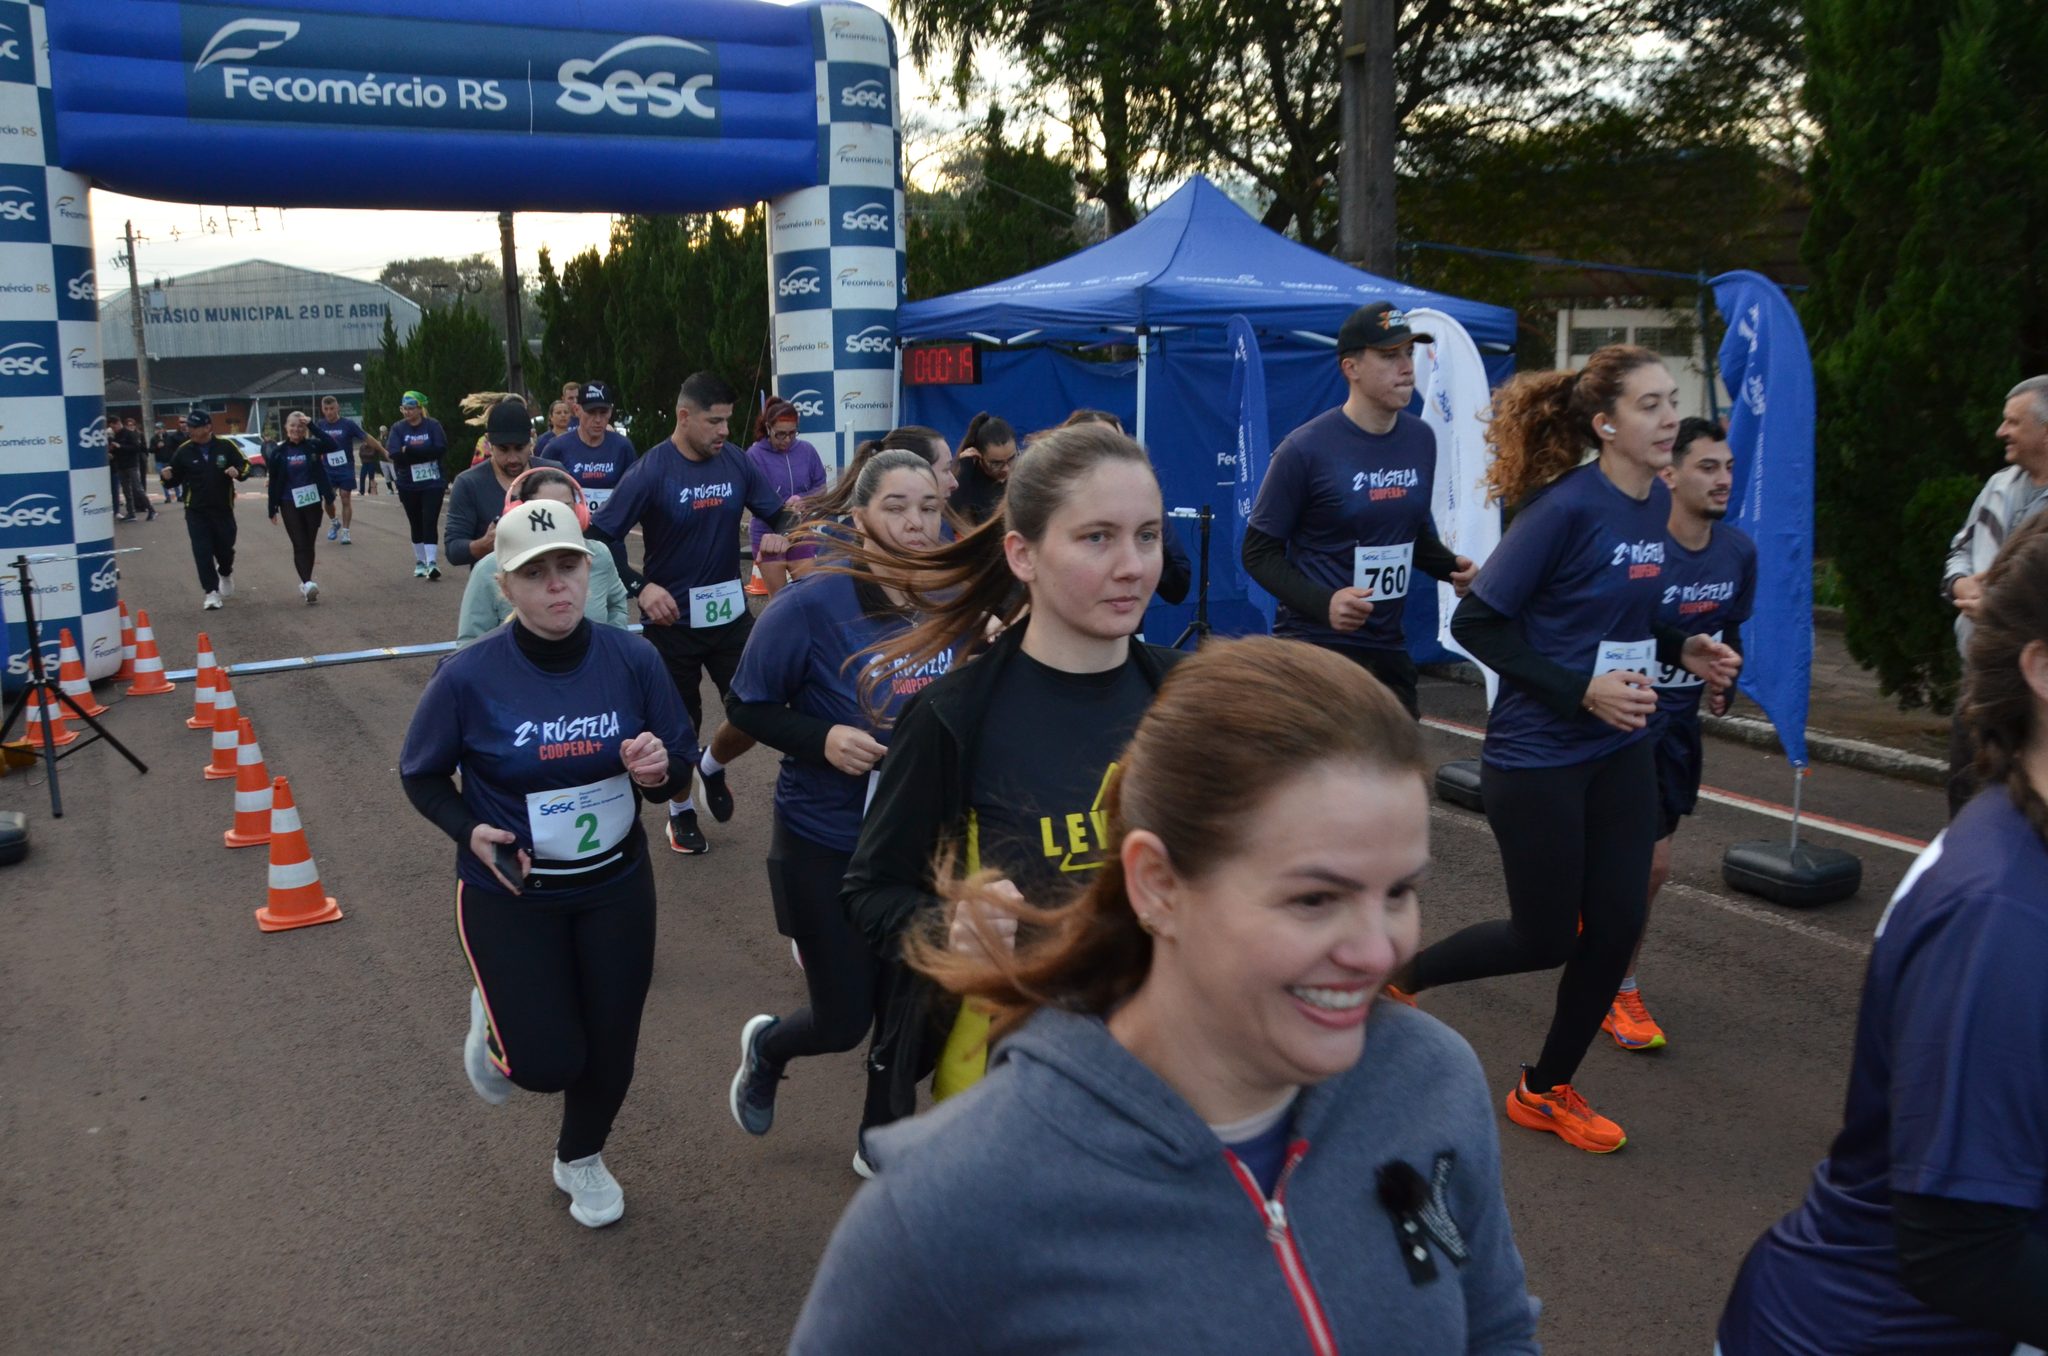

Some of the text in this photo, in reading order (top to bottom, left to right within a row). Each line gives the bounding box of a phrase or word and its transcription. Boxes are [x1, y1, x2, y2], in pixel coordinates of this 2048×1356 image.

[223, 66, 508, 111] Fecomércio RS
[556, 58, 716, 119] Sesc
[21, 126, 38, 137] RS
[841, 210, 889, 232] Sesc
[778, 276, 820, 297] Sesc
[205, 305, 294, 323] MUNICIPAL
[299, 304, 320, 320] 29
[324, 303, 345, 319] DE
[845, 333, 891, 353] Sesc
[48, 436, 63, 445] RS
[694, 482, 733, 499] RÚSTICA
[1365, 564, 1406, 595] 760
[706, 598, 732, 623] 84
[542, 711, 620, 744] RÚSTICA
[539, 740, 603, 760] COOPERA+
[575, 812, 601, 854] 2
